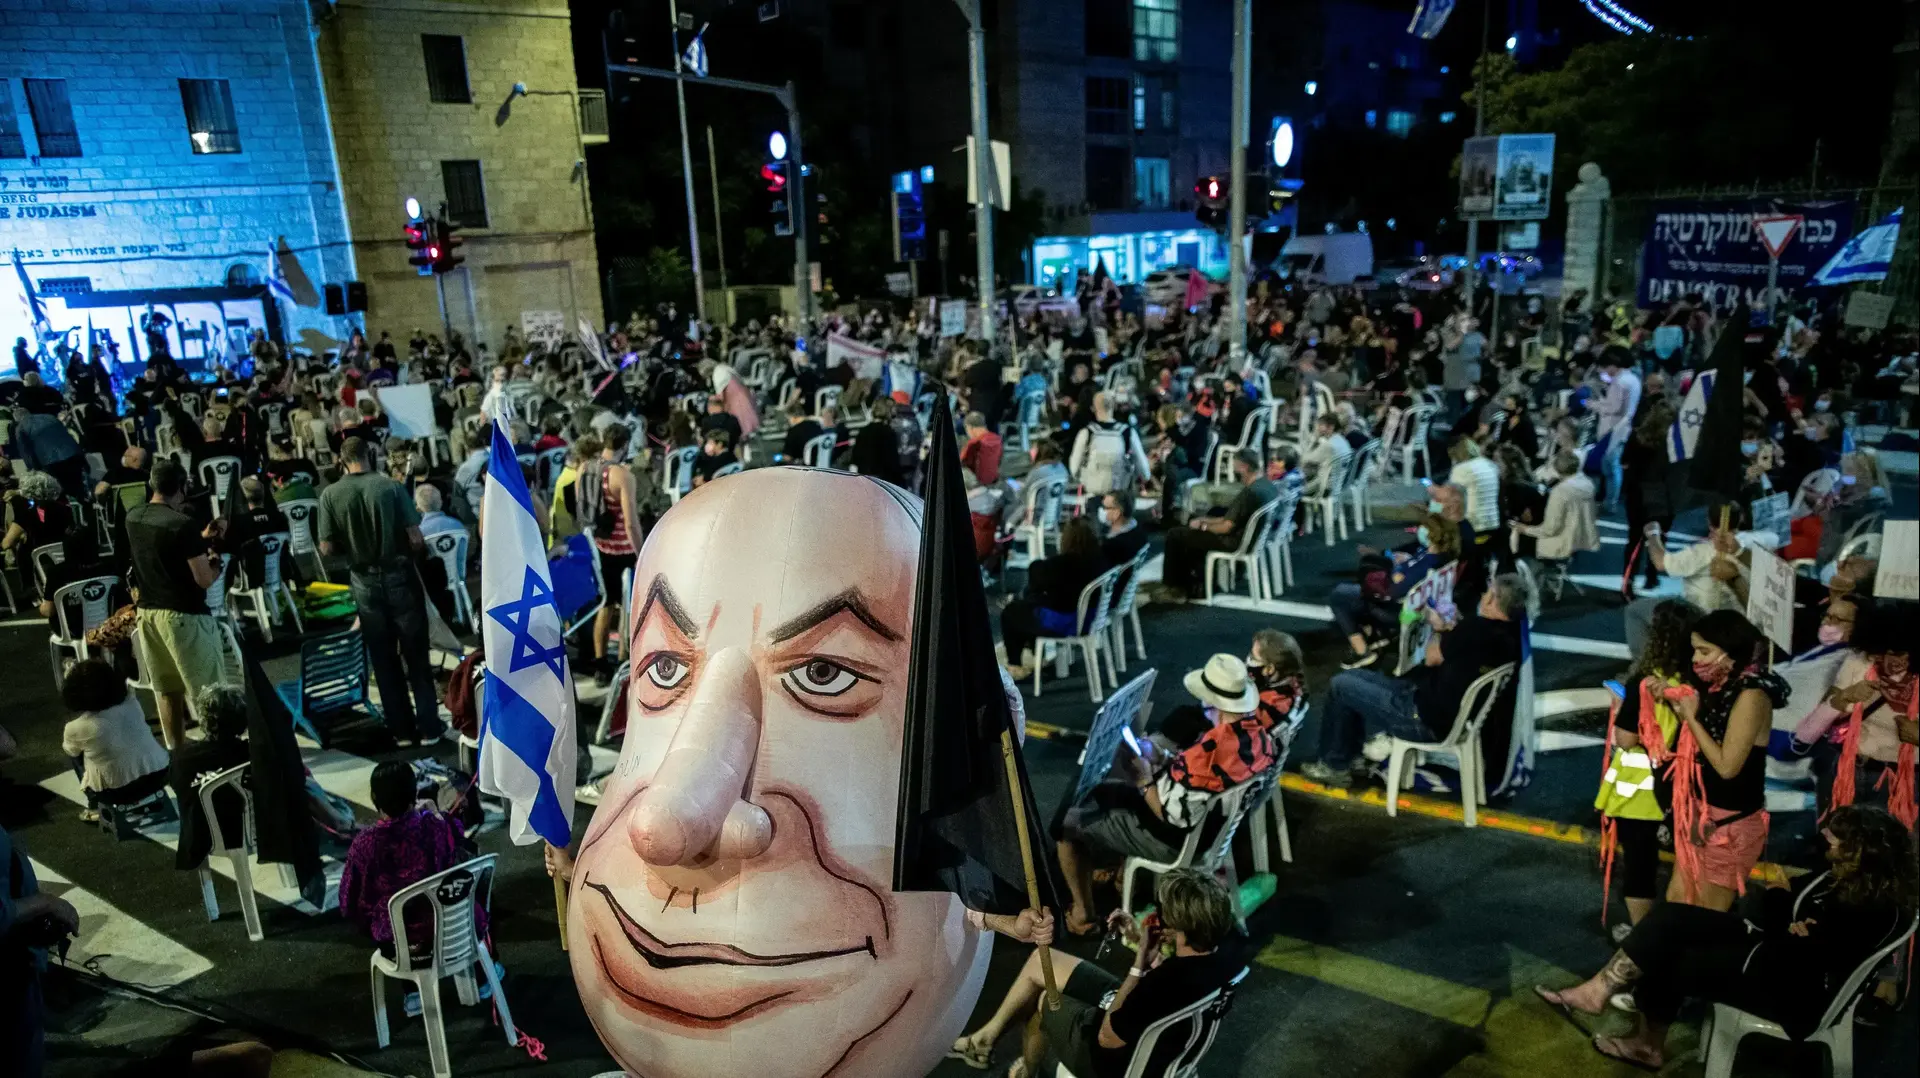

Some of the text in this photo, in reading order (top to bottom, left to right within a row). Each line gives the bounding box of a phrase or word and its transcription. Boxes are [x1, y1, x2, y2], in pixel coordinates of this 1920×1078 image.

[17, 205, 97, 219] JUDAISM
[52, 246, 116, 257] המאוחדים
[120, 244, 159, 255] הכנסת
